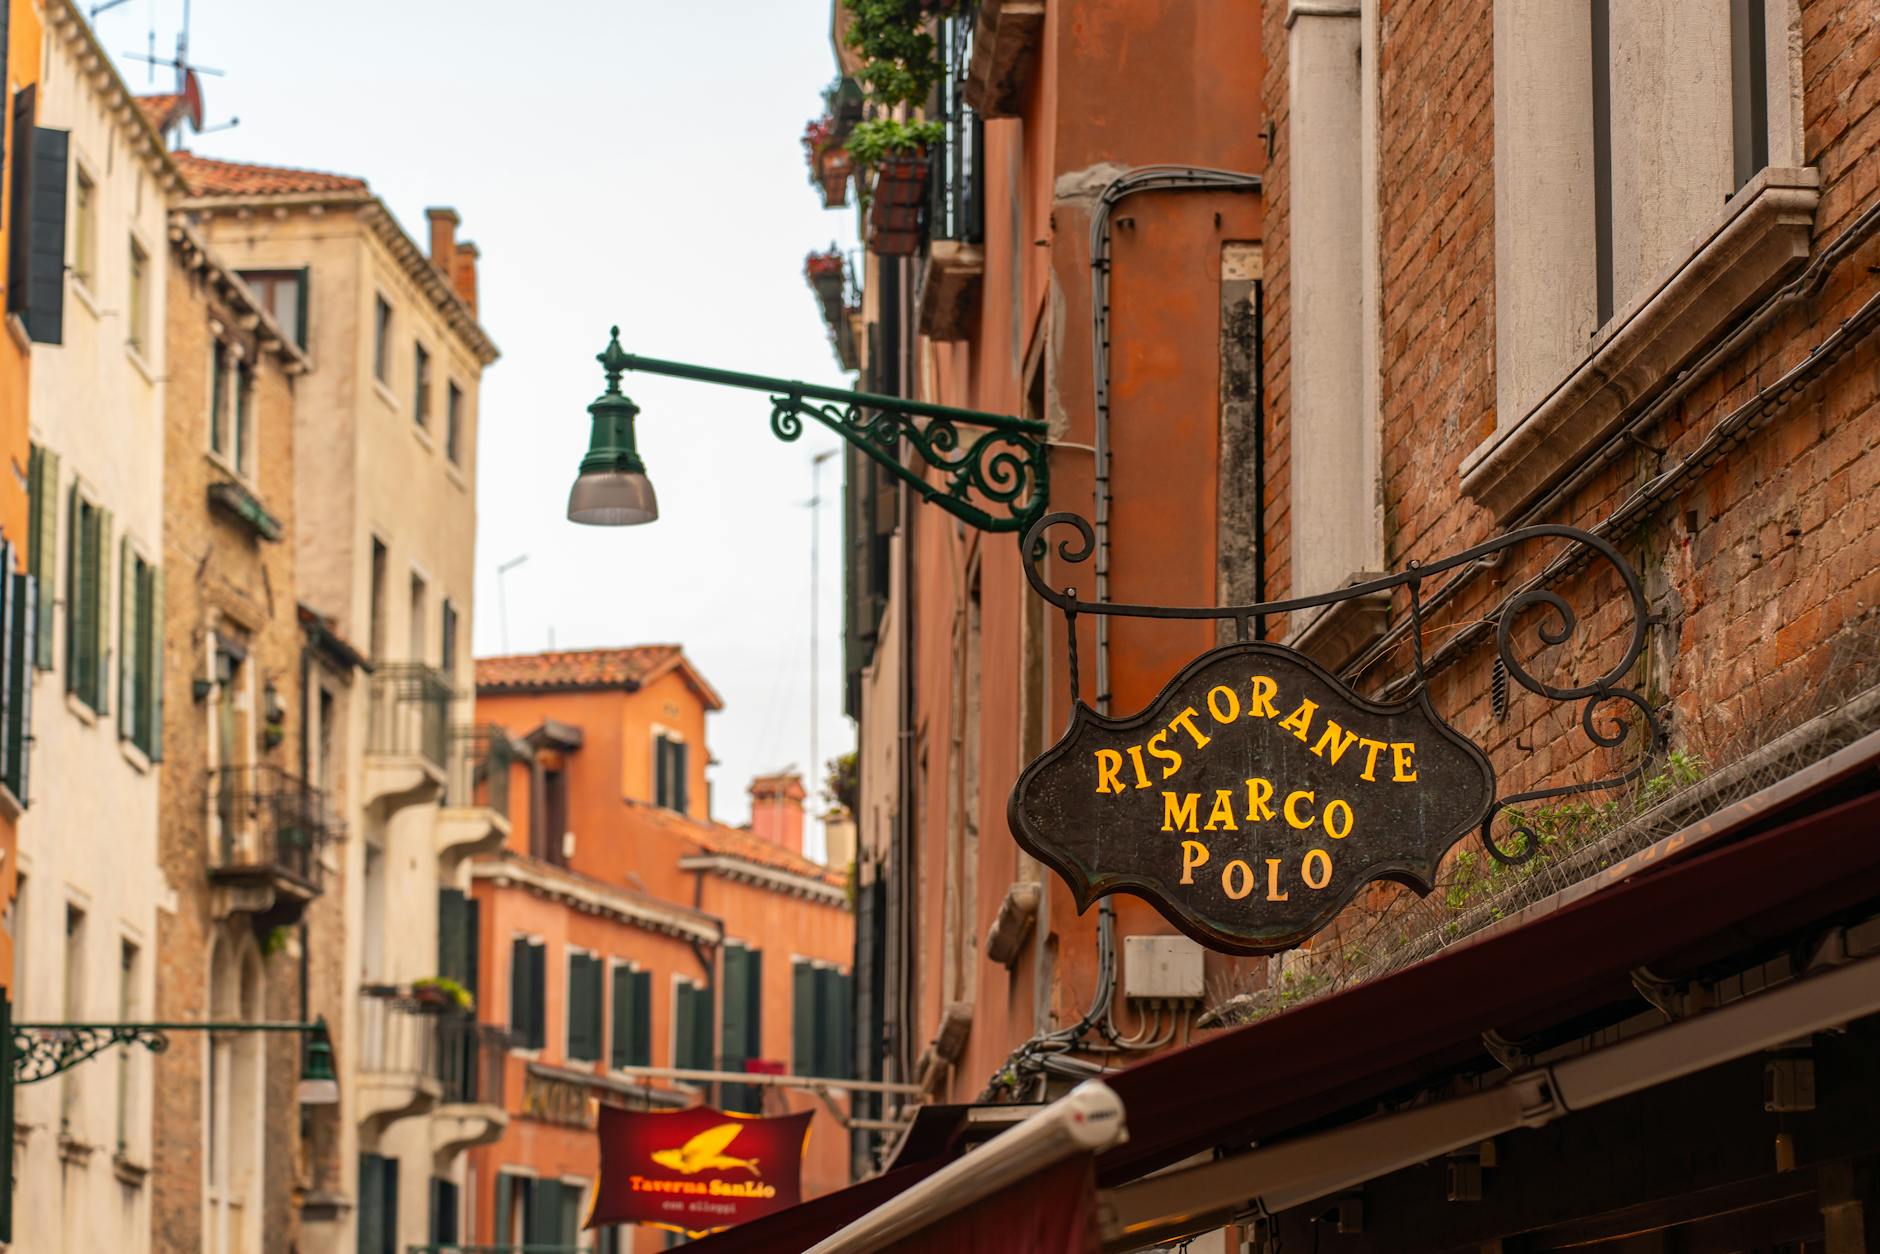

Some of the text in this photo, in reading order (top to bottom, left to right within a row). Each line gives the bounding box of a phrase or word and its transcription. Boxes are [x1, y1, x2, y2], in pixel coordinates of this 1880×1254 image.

[1094, 675, 1418, 795] RISTORANTE
[1160, 777, 1354, 839] MARCO
[1179, 840, 1334, 903] POLO
[629, 1175, 708, 1195] Taverna
